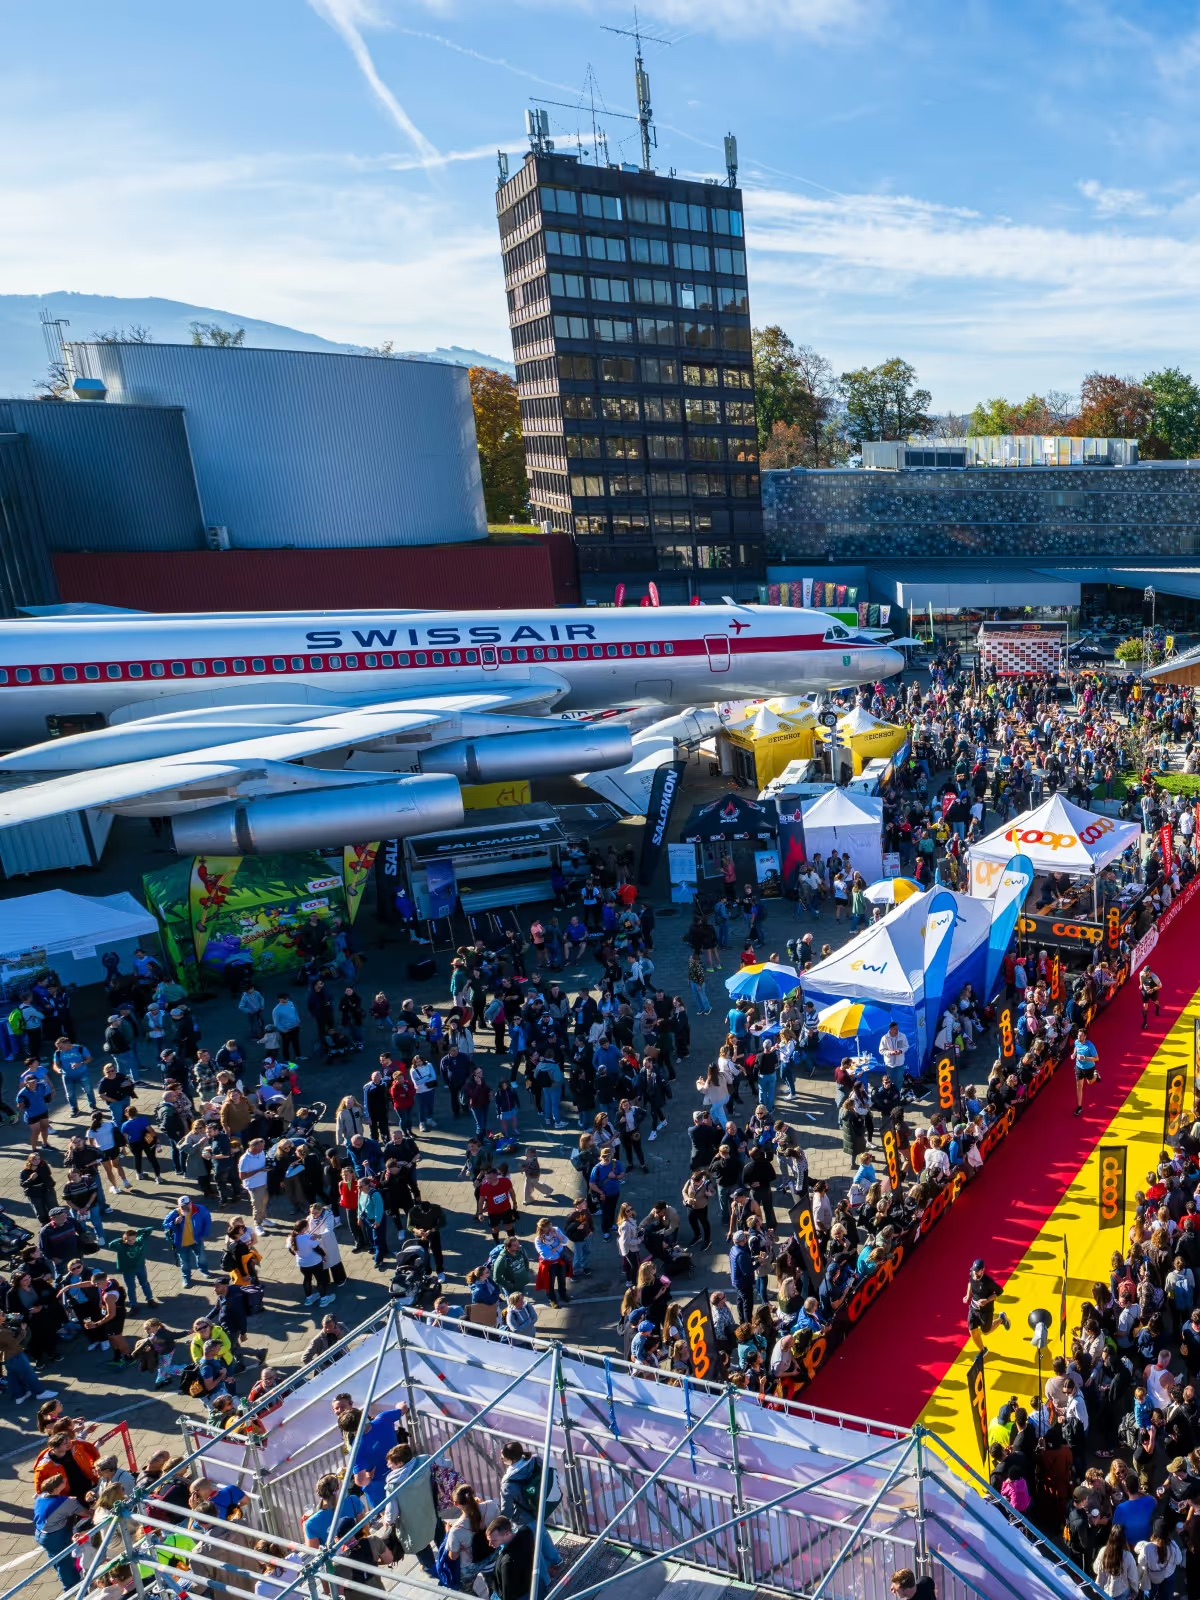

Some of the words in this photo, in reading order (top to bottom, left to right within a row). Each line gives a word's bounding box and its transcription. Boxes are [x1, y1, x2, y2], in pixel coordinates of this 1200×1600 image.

[305, 624, 597, 649] SWISSAIR
[652, 769, 679, 846] SALOMON
[437, 834, 540, 850] SALOMON
[1005, 829, 1077, 850] coop
[1079, 817, 1115, 845] coop
[311, 878, 340, 890] coop
[305, 901, 326, 909] coop
[931, 916, 950, 929] ewl
[1053, 922, 1103, 943] coop
[851, 959, 887, 974] ewl
[938, 1058, 955, 1110] coop
[884, 1130, 899, 1190] coop
[1102, 1156, 1122, 1220] coop
[921, 1171, 967, 1233] coop
[848, 1246, 904, 1322] coop
[687, 1309, 708, 1379] coop
